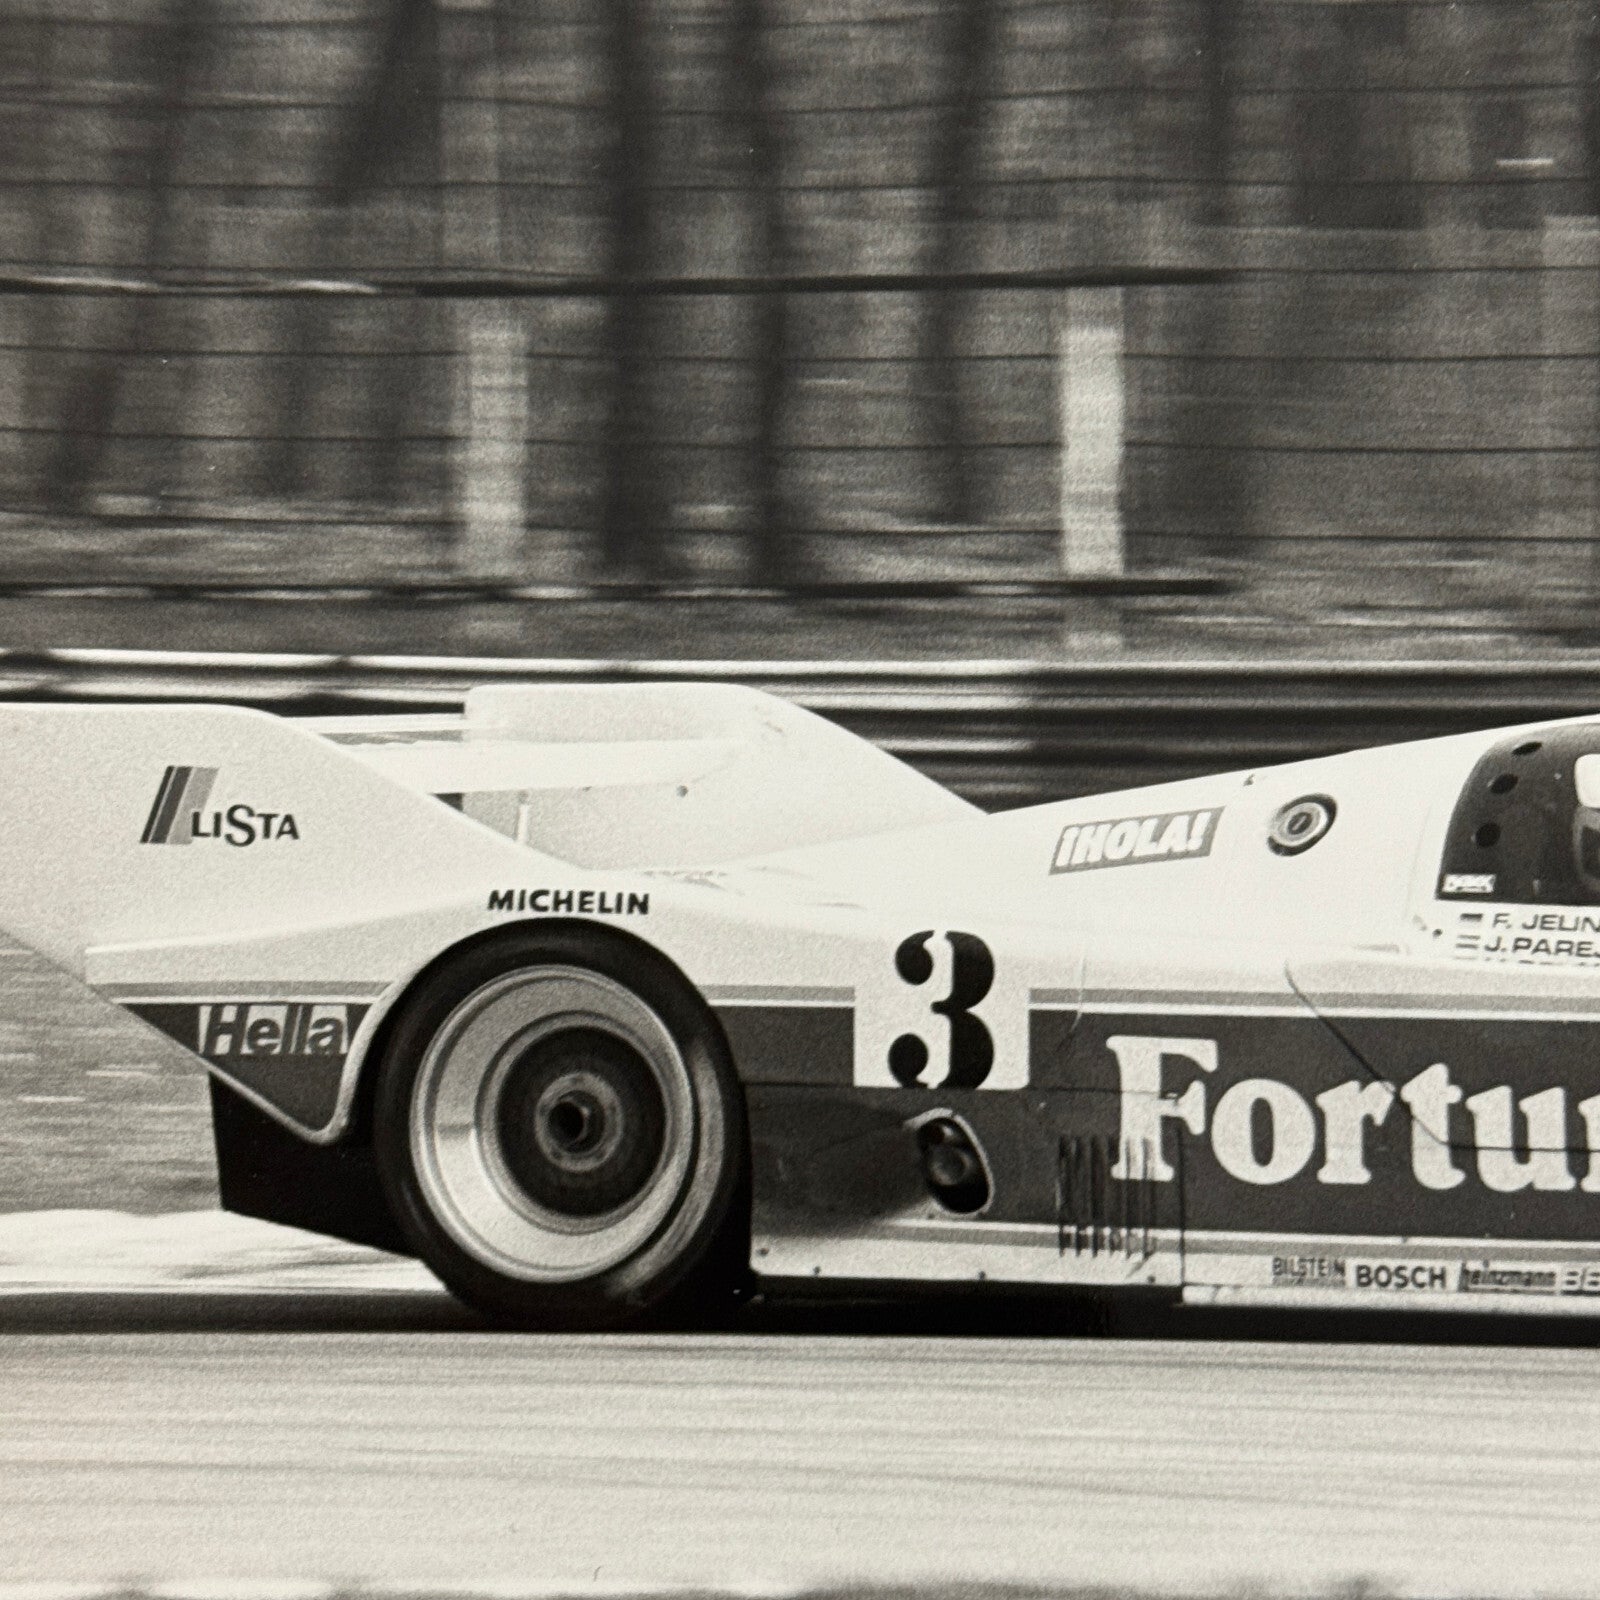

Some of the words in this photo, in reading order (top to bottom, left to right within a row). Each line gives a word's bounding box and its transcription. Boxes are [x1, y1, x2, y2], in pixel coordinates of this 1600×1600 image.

[190, 804, 300, 847] LISTA
[487, 888, 650, 915] MICHELIN
[888, 929, 996, 1090] 3
[203, 1003, 348, 1057] Hella
[1272, 1257, 1346, 1277] BILSTEIN
[1356, 1264, 1447, 1289] BOSCH
